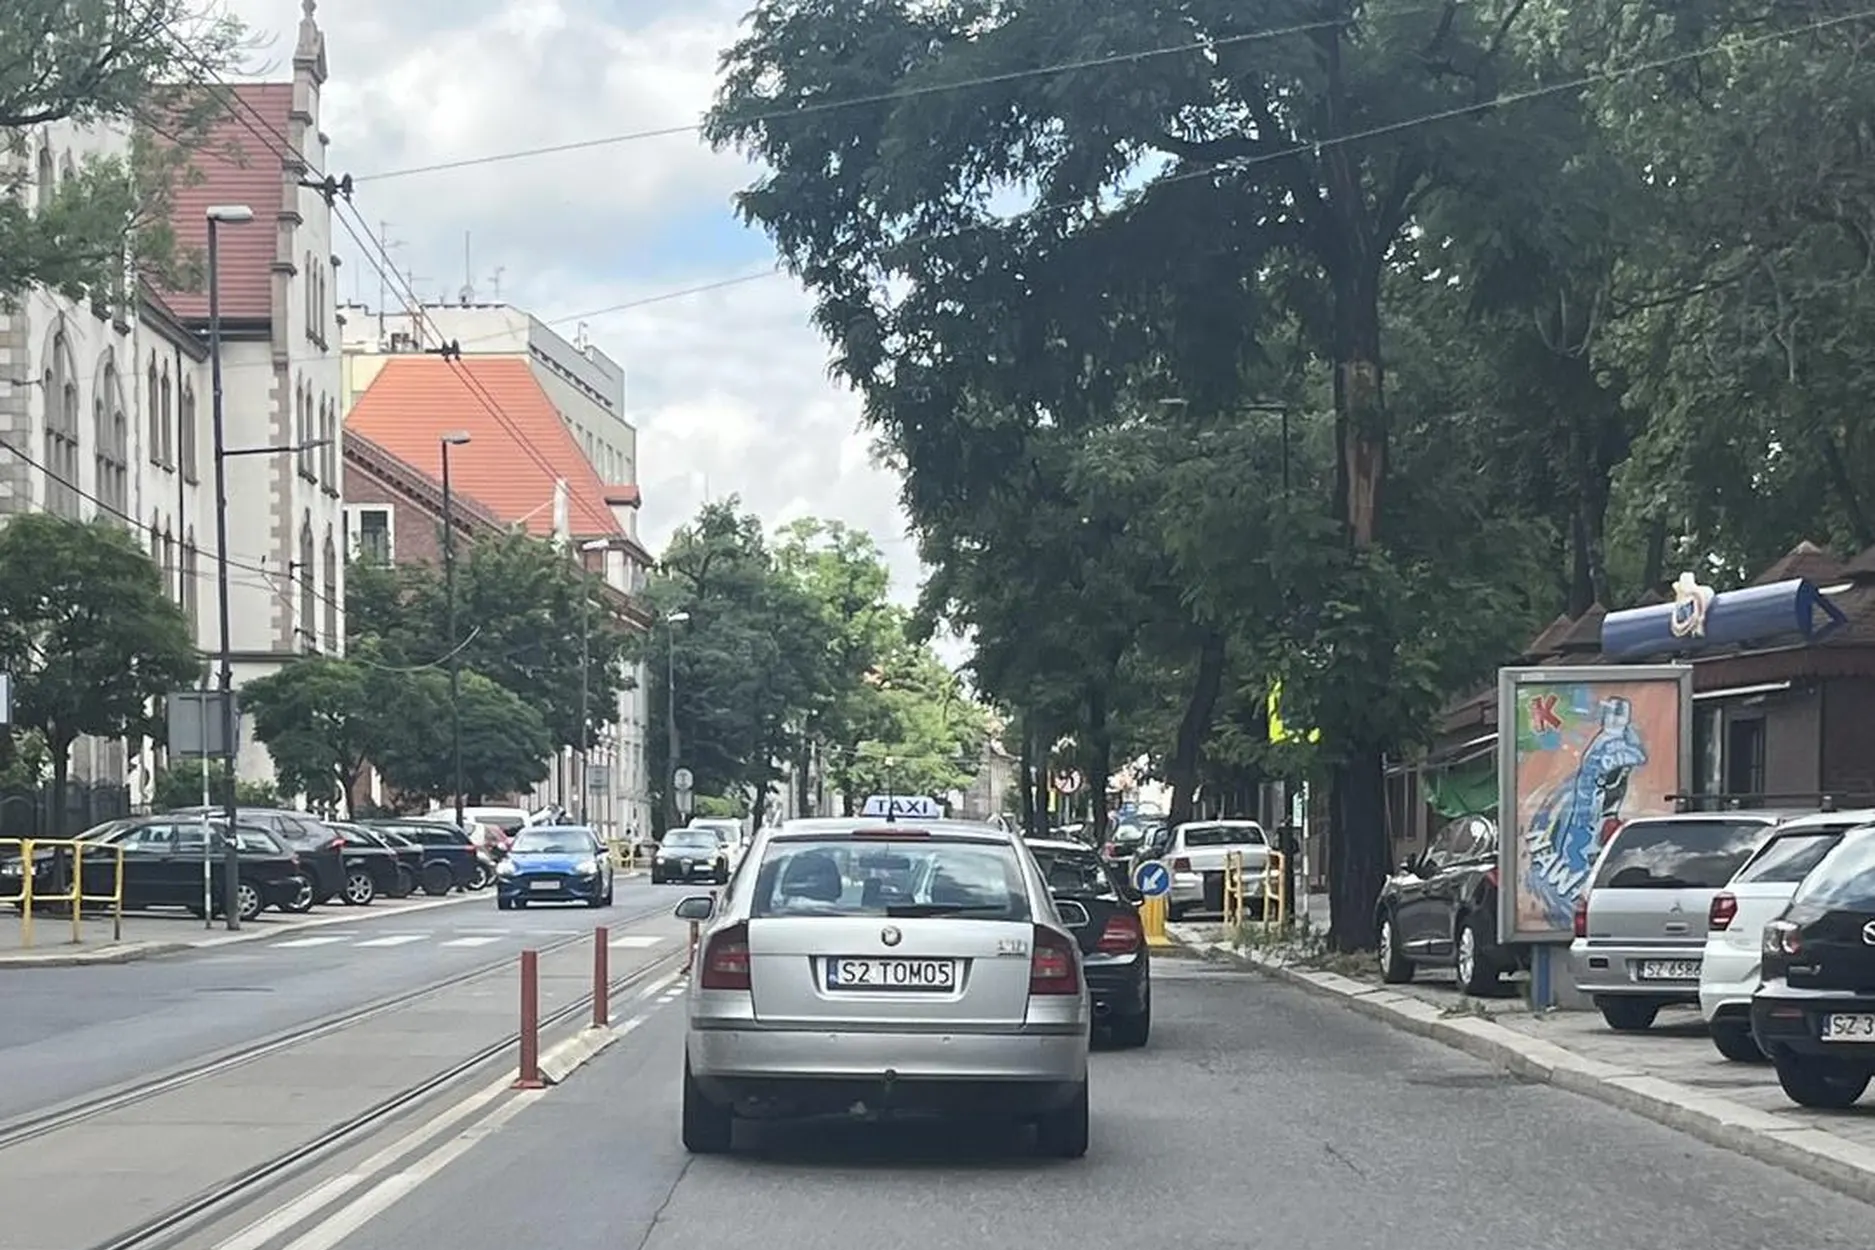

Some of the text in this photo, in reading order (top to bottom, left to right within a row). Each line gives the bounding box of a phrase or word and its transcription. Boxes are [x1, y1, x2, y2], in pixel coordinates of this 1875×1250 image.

[1530, 694, 1562, 732] K
[875, 799, 928, 814] TAXI
[842, 961, 870, 984] S2
[1833, 1015, 1857, 1035] SZ
